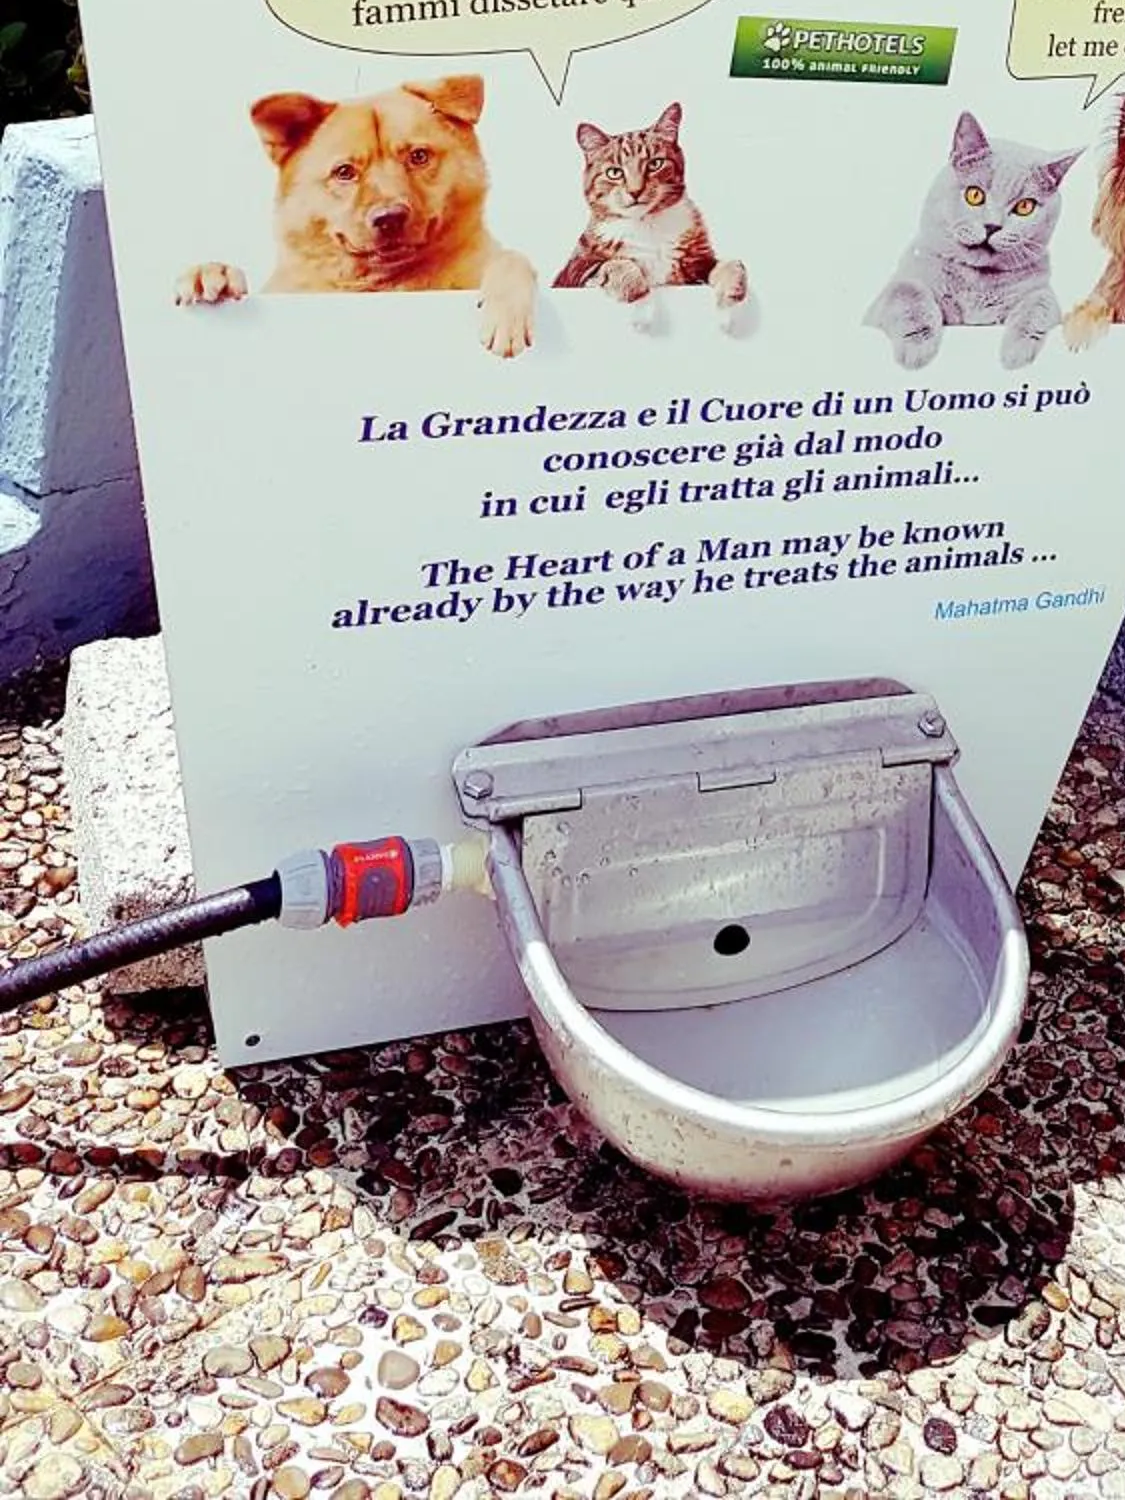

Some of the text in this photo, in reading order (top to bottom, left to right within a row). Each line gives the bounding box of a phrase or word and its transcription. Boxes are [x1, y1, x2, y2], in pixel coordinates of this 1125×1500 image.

[763, 58, 805, 71] 100%
[793, 29, 925, 55] PETHOTELS
[1048, 34, 1077, 57] let
[1083, 38, 1118, 57] me
[358, 382, 1091, 442] La Grandezza e il Cuore di un Uomo si può
[543, 425, 942, 473] conoscere già dal modo
[479, 461, 979, 518] in cui egli tratta gli animali...
[422, 519, 1005, 588] The Heart of a Man may be known
[331, 590, 484, 629] already
[492, 587, 537, 618] by
[546, 581, 605, 609] the
[614, 578, 685, 604] way
[692, 568, 735, 595] he
[744, 557, 839, 589] treats
[848, 553, 897, 579] the
[905, 542, 1025, 574] animals
[934, 586, 1106, 620] Mahatma Gandhi
